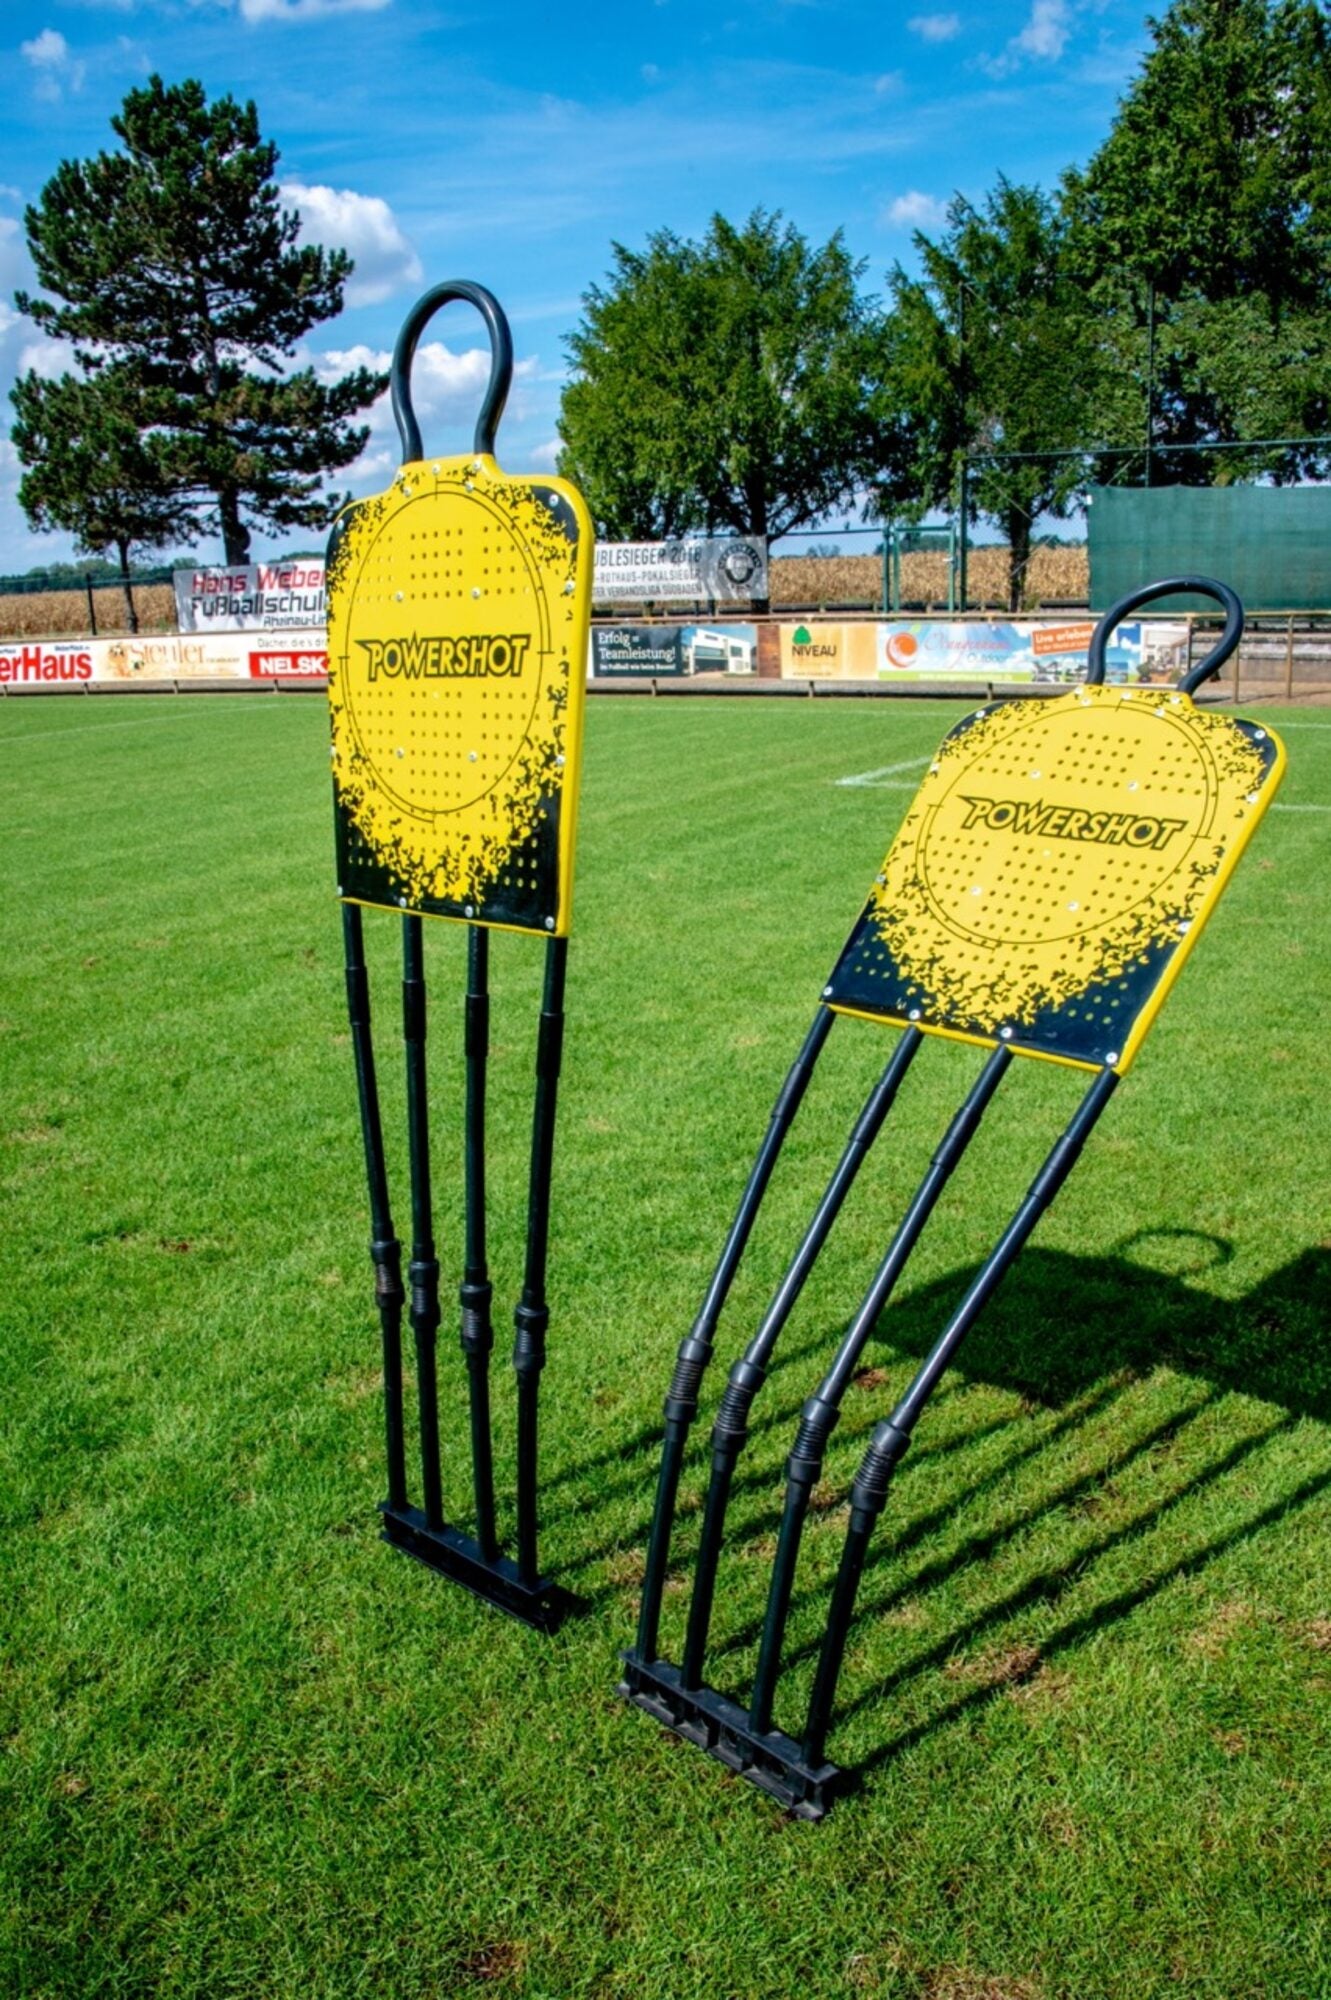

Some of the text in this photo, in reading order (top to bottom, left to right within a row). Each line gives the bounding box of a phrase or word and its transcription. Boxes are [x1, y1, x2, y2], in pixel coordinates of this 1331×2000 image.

[192, 572, 247, 594] Hans
[598, 631, 630, 647] Erfolg
[354, 631, 531, 682] POWERSHOT
[598, 646, 676, 663] Teamleistung!
[792, 645, 837, 657] NIVEAU
[956, 795, 1189, 851] POWERSHOT
